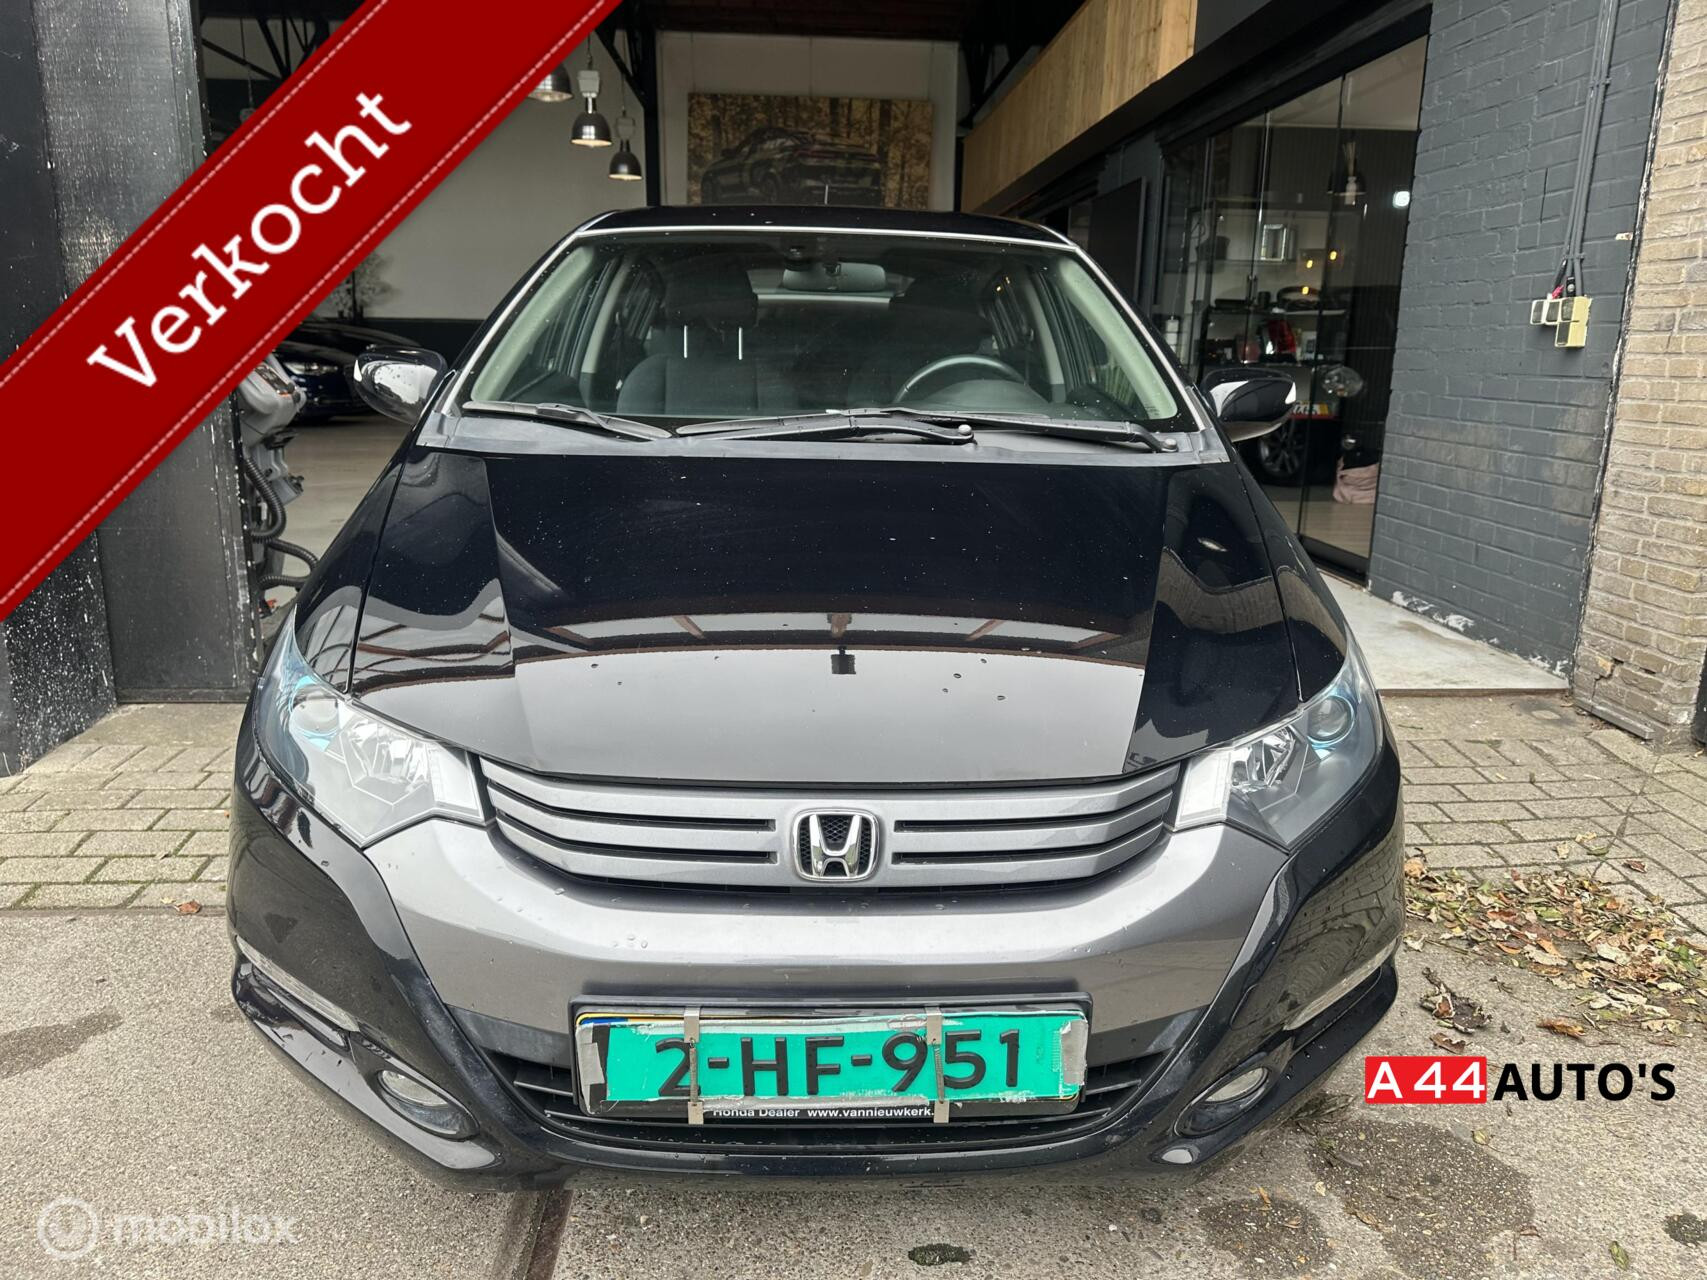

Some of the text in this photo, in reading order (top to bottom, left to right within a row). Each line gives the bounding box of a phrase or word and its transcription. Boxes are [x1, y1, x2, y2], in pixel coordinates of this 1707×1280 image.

[655, 1030, 1020, 1097] 2-HF-951
[759, 1107, 800, 1117] Dealer
[807, 1107, 935, 1119] www.vannieuwkerk.
